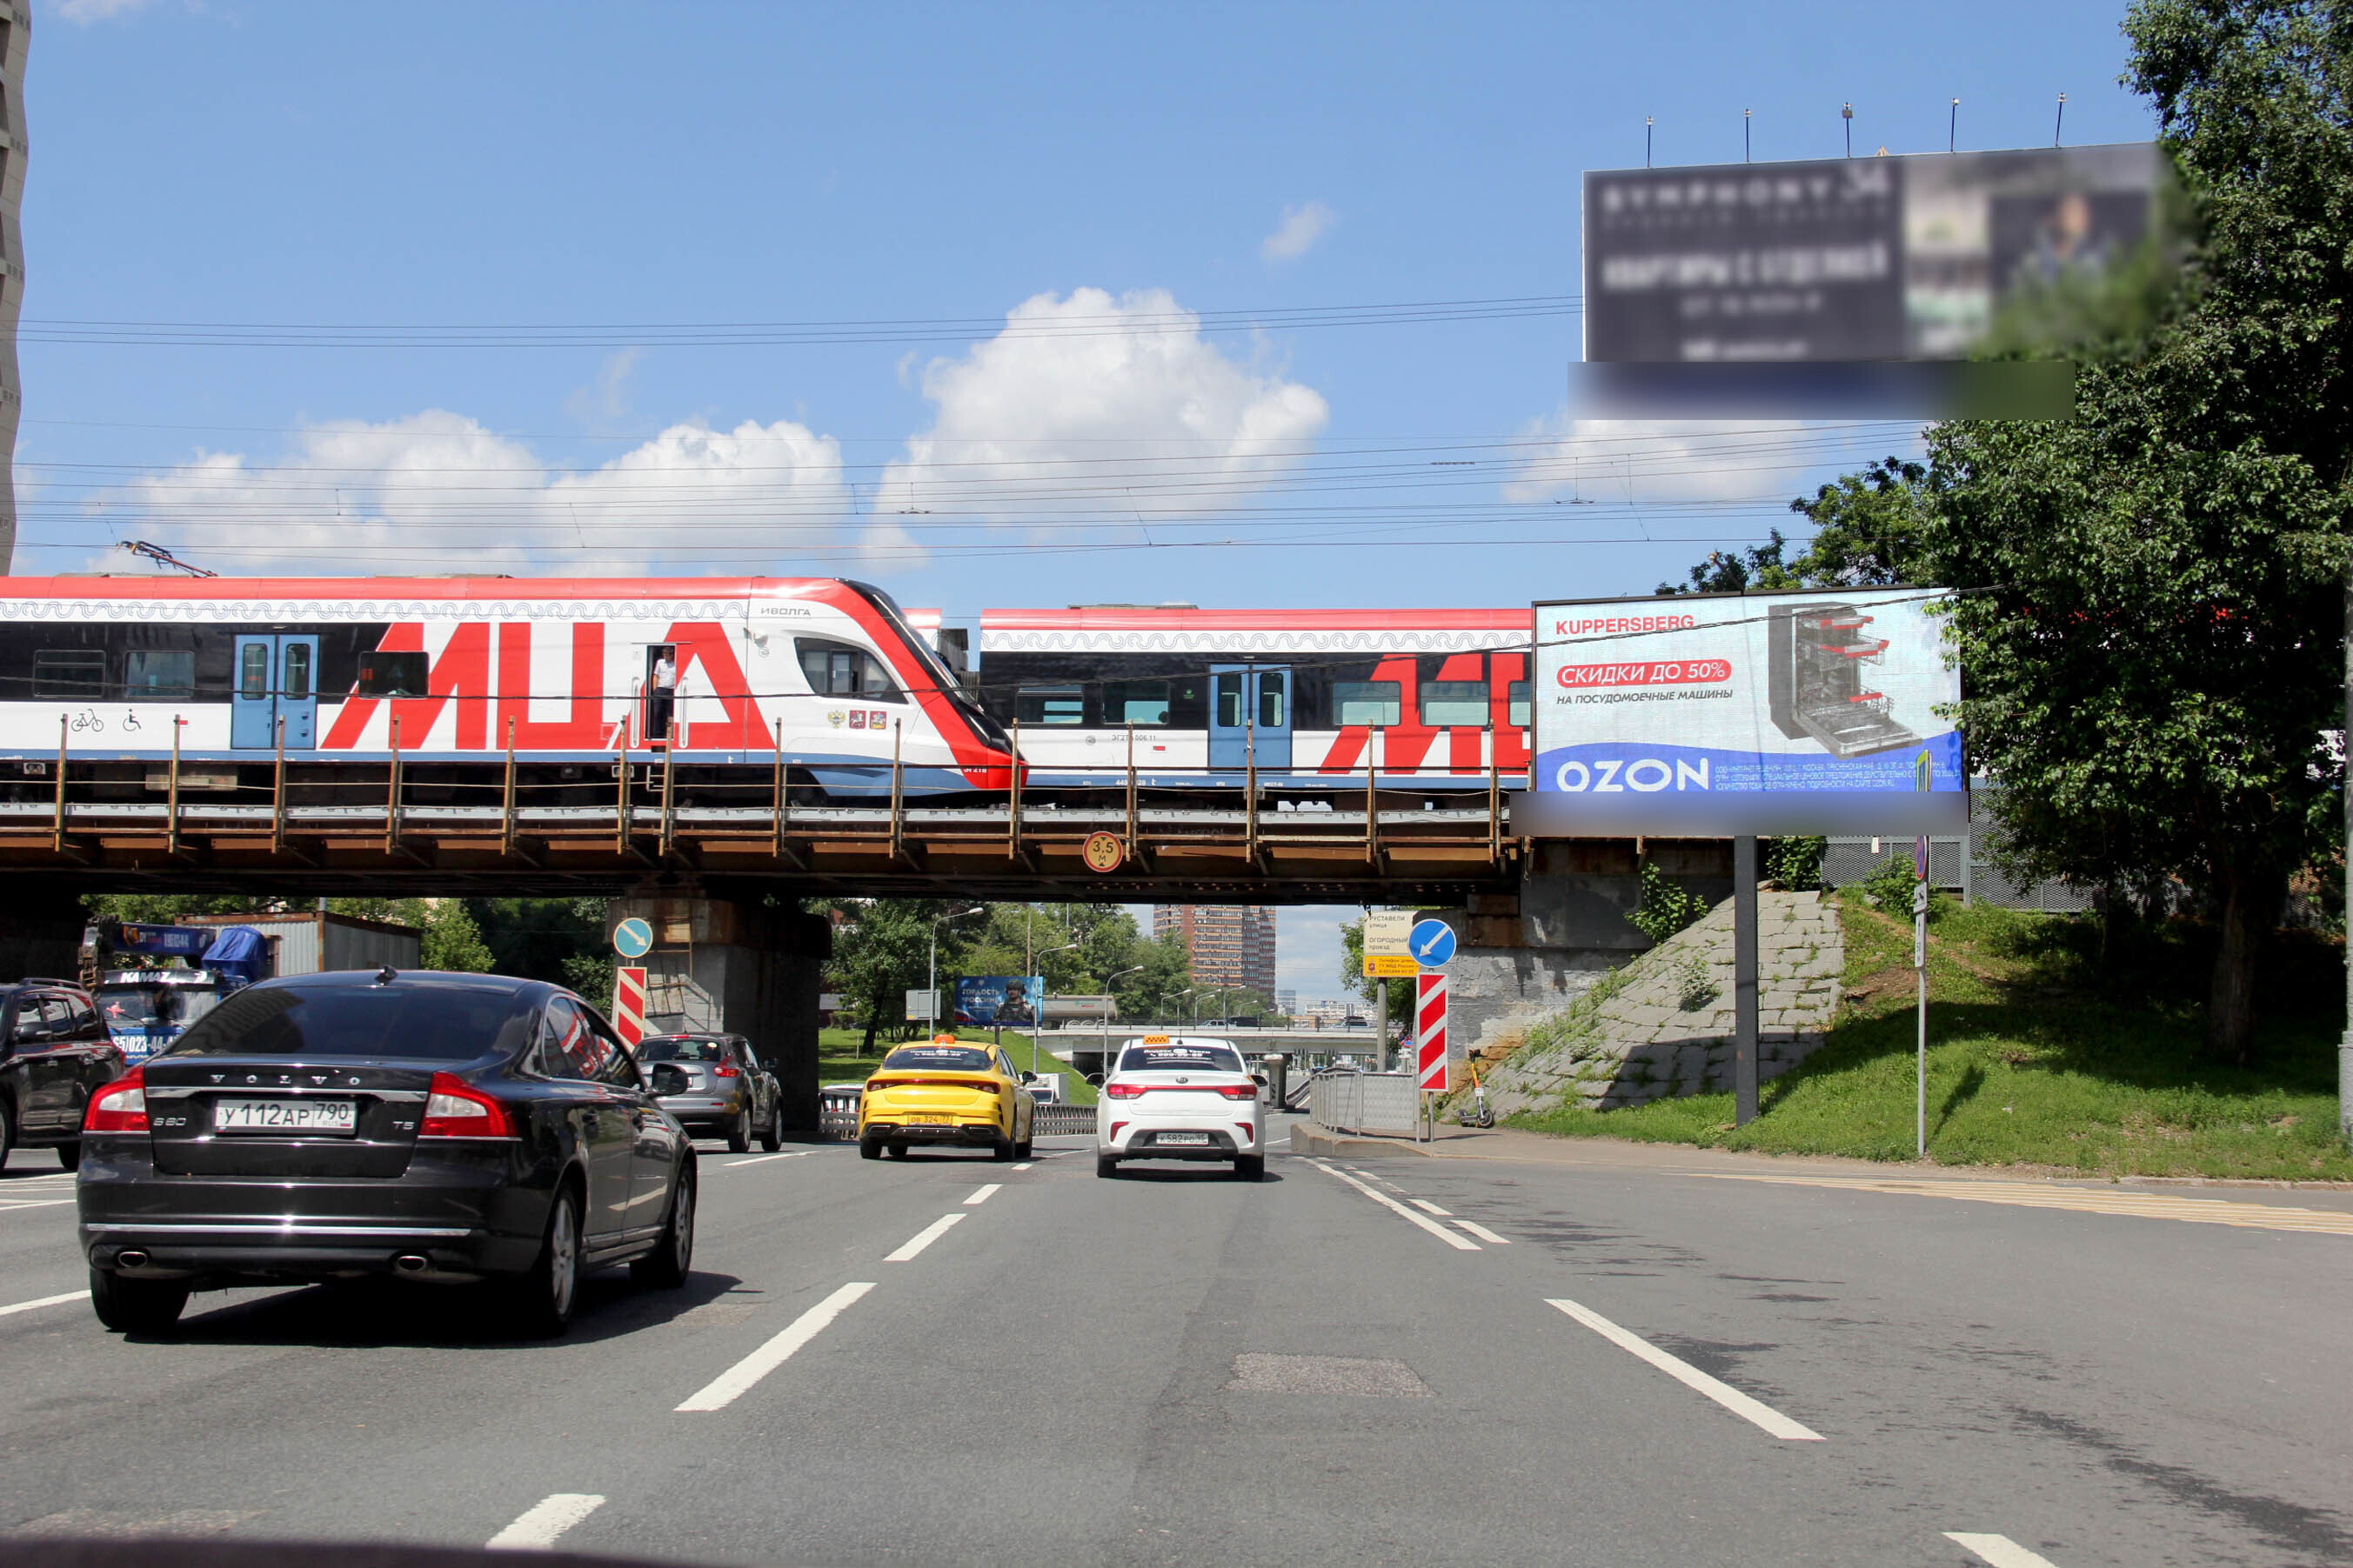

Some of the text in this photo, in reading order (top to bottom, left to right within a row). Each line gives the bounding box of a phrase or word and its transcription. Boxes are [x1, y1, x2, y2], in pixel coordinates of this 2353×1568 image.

[761, 607, 811, 617] ИВОЛГА
[1555, 615, 1695, 635] KUPPERSBERG
[1561, 661, 1727, 685] СКИДКИ ДО 50%
[1556, 688, 1734, 704] НА ПОСУДОМОЕЧНЫЕ МАШИНЫ
[1555, 758, 1710, 792] OZON
[1093, 840, 1114, 854] 3,5
[120, 971, 170, 984] KAMAZ
[211, 1074, 361, 1085] VOLVO
[316, 1103, 349, 1121] 790
[392, 1120, 416, 1131] T5
